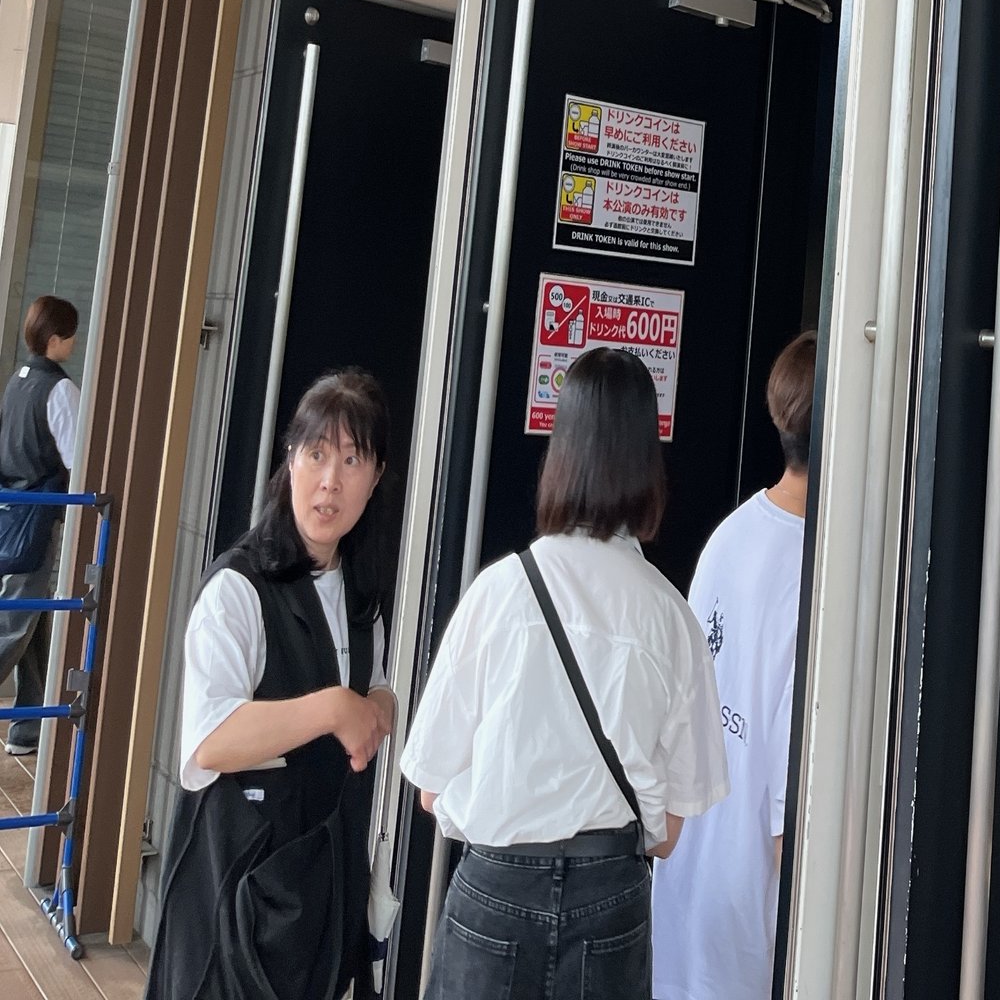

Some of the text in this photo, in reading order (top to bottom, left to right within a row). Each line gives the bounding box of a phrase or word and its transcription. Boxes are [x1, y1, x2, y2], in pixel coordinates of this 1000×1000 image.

[607, 109, 680, 134] ドリンクコインは
[604, 126, 697, 154] 早めにご利用ください
[565, 152, 697, 182] Please use DRINK TOKEN before show start.
[570, 164, 691, 190] (Drink shop will be very crowded after show end.)
[606, 180, 680, 204] ドリンクコインは
[602, 198, 687, 222] 本公演のみ有効です
[571, 231, 680, 253] DRINK TOKEN is valid for this show.
[550, 292, 563, 301] 500
[592, 290, 655, 307] 現金又は交通系ICで
[595, 306, 621, 321] 入場時
[589, 311, 678, 344] ドリンク代 600円
[532, 412, 543, 420] 600
